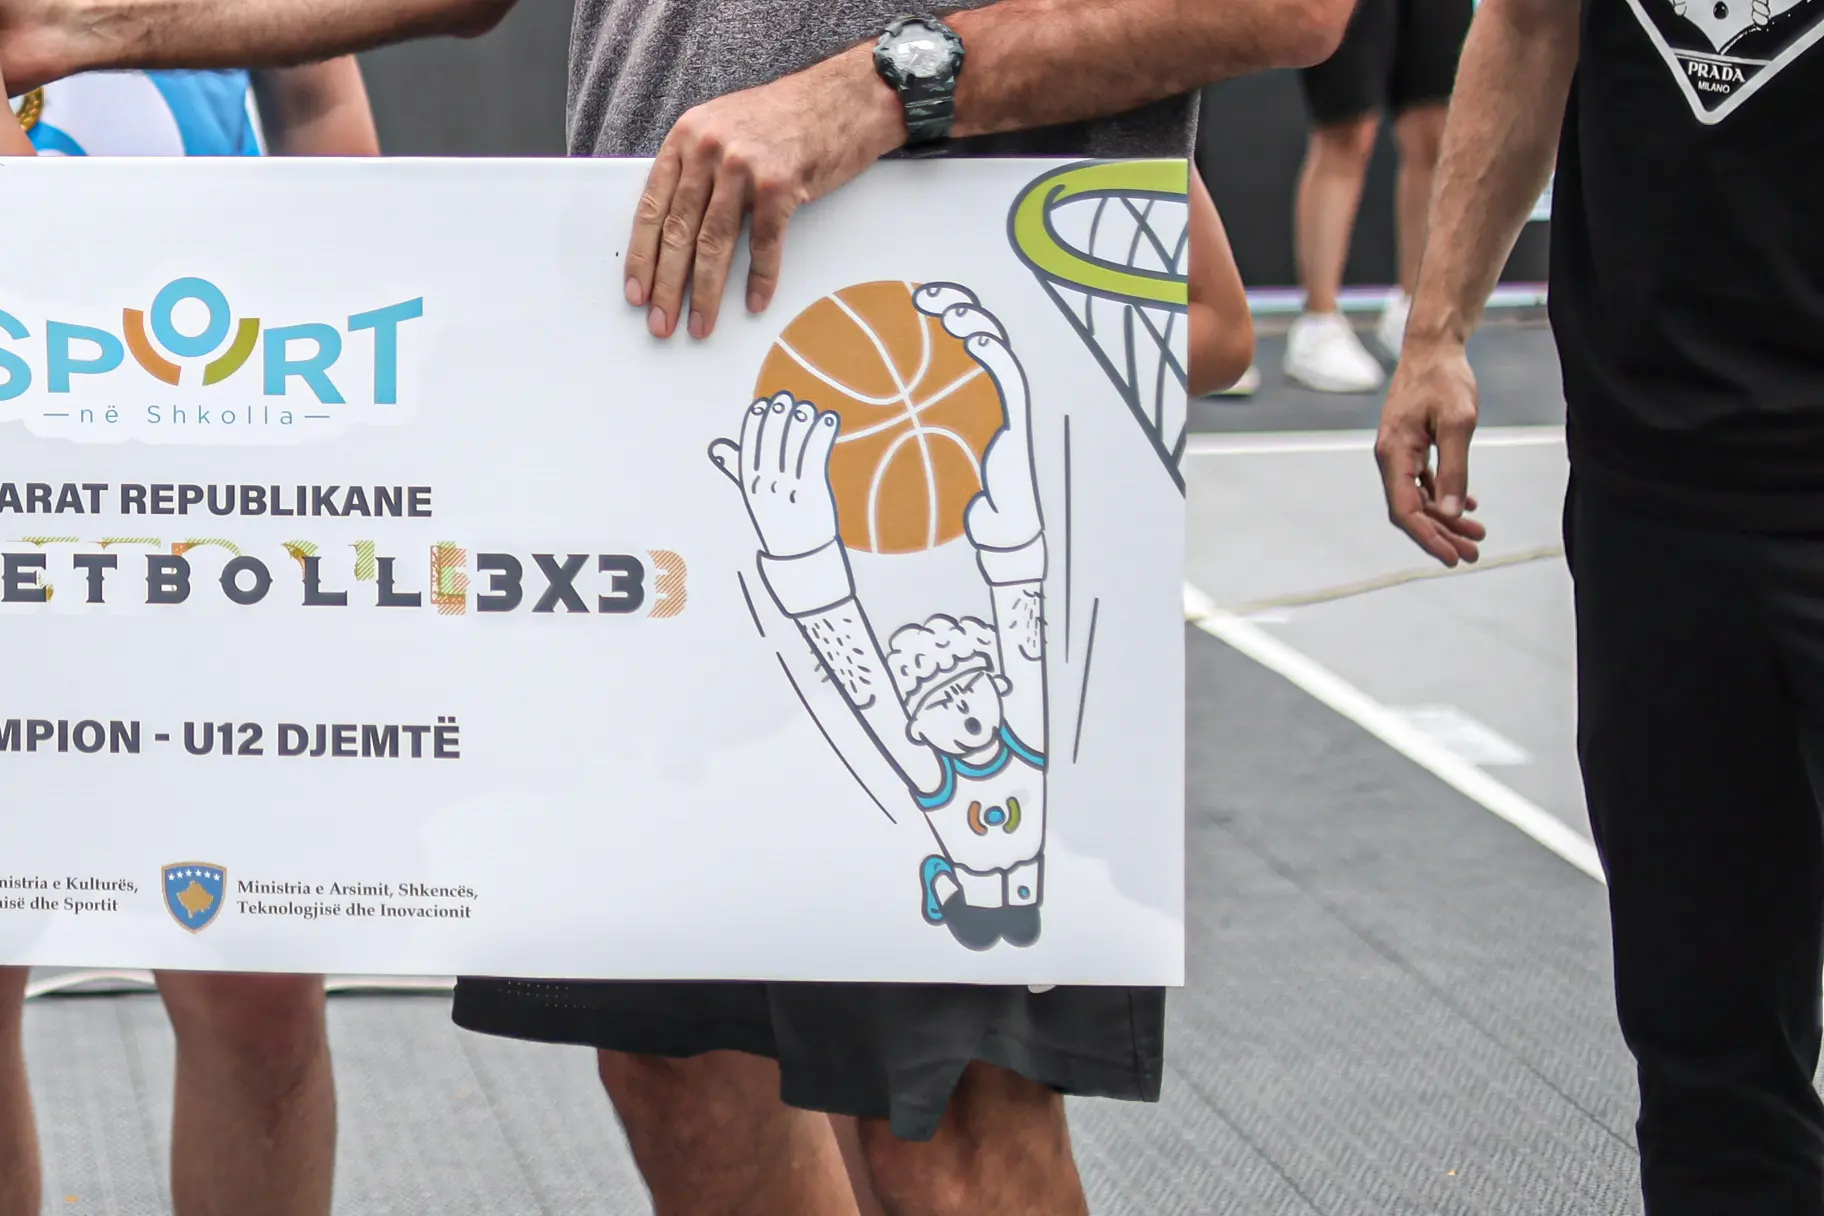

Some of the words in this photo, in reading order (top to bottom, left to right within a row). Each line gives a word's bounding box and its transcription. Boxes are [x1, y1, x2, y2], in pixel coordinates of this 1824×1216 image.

[1688, 61, 1747, 83] PRADA
[1697, 80, 1731, 94] MILANO
[80, 404, 119, 424] në
[146, 404, 294, 425] Shkolla
[120, 483, 433, 518] REPUBLIKANE
[475, 552, 645, 615] 3X3
[183, 721, 264, 756] U12
[277, 716, 461, 759] DJEMTË
[53, 880, 61, 890] e
[66, 876, 139, 894] Kulturës,
[237, 880, 311, 895] Ministria
[315, 885, 324, 895] e
[330, 882, 394, 899] Arsimit,
[398, 883, 479, 900] Shkencës,
[29, 897, 59, 911] dhe
[64, 897, 118, 915] Sportit
[237, 900, 341, 920] Teknologjisë
[345, 903, 376, 917] dhe
[381, 903, 471, 919] Inovacionit
